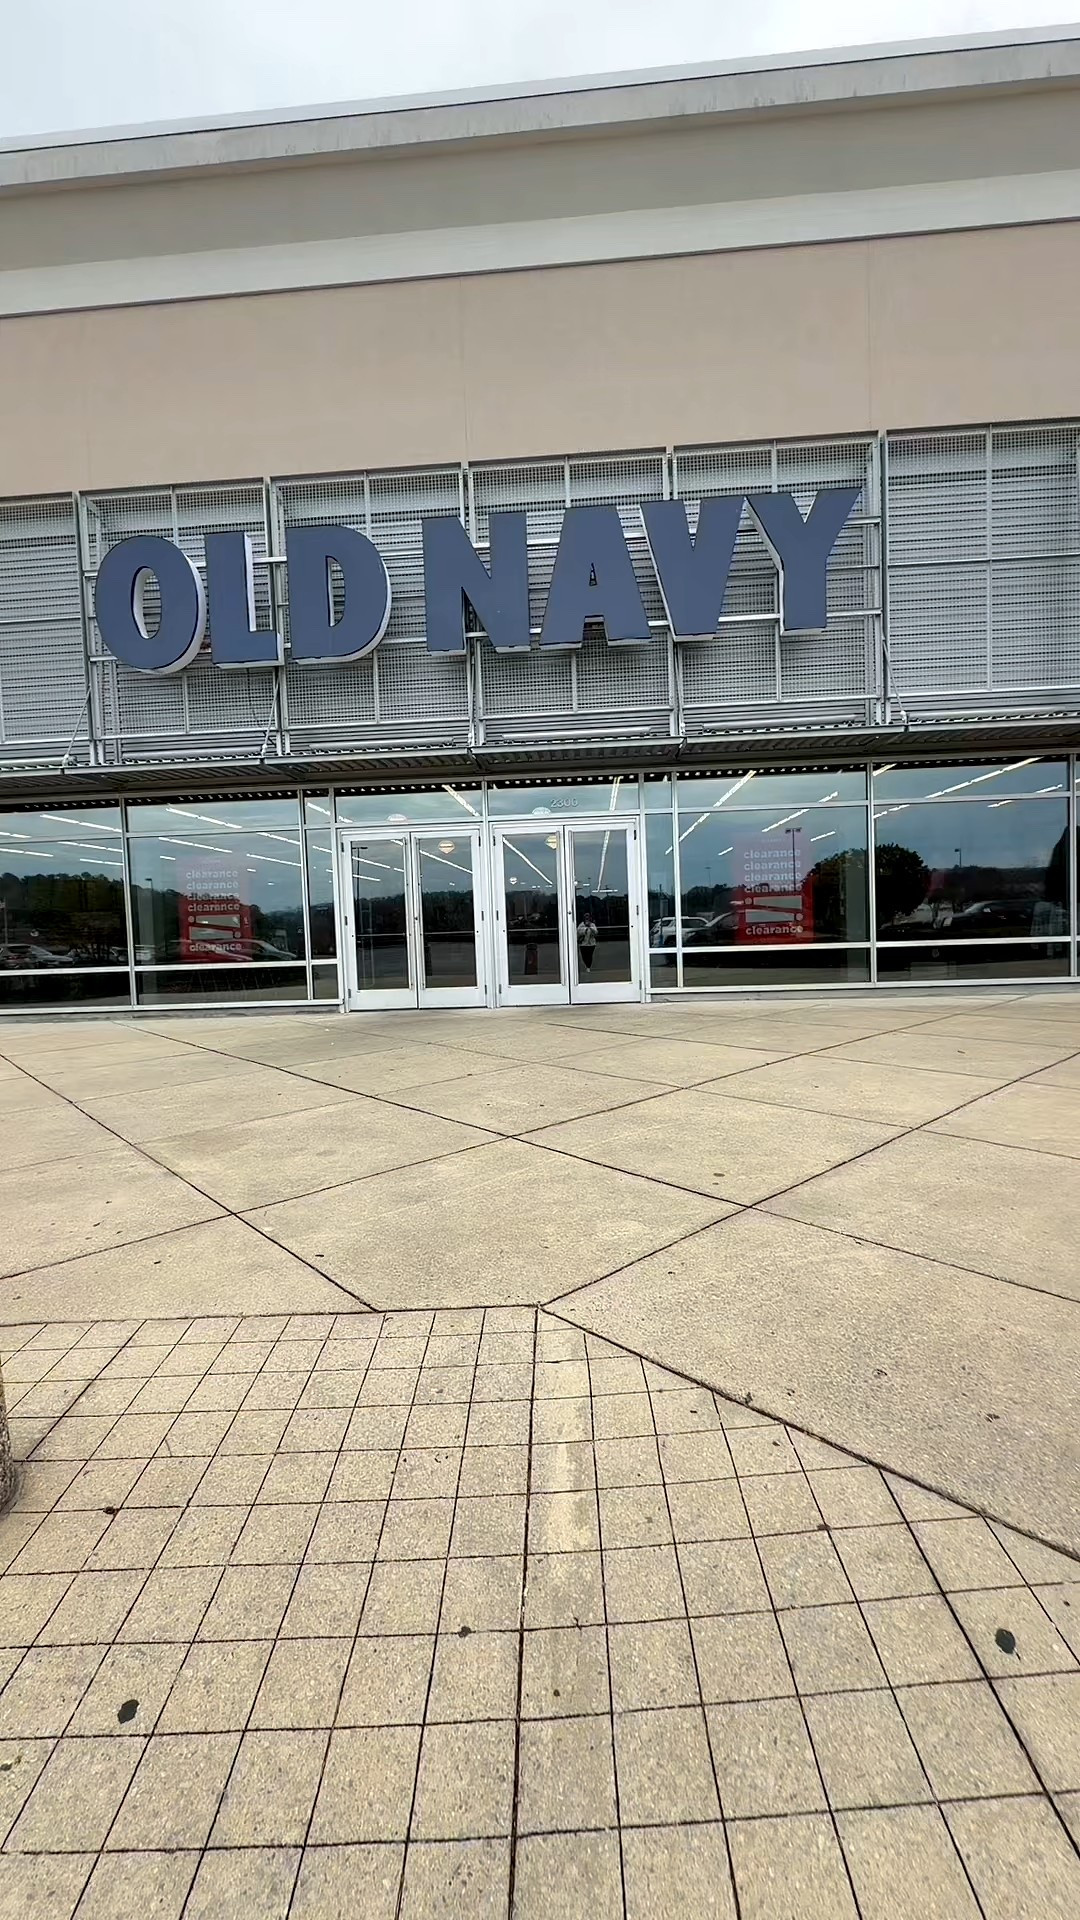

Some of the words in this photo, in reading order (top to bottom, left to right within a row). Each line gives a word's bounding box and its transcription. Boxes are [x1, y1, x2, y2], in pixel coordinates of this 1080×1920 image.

[96, 524, 392, 674] OLD
[421, 487, 859, 654] NAVY
[550, 798, 578, 808] 2300
[743, 849, 801, 859] clearance
[743, 860, 801, 870] clearance
[185, 870, 238, 879] clearance
[744, 872, 801, 882] clearance
[186, 881, 239, 890] clearance
[744, 883, 803, 893] clearance
[187, 903, 240, 912] clearance
[745, 925, 804, 935] clearance
[189, 942, 242, 952] clearance
